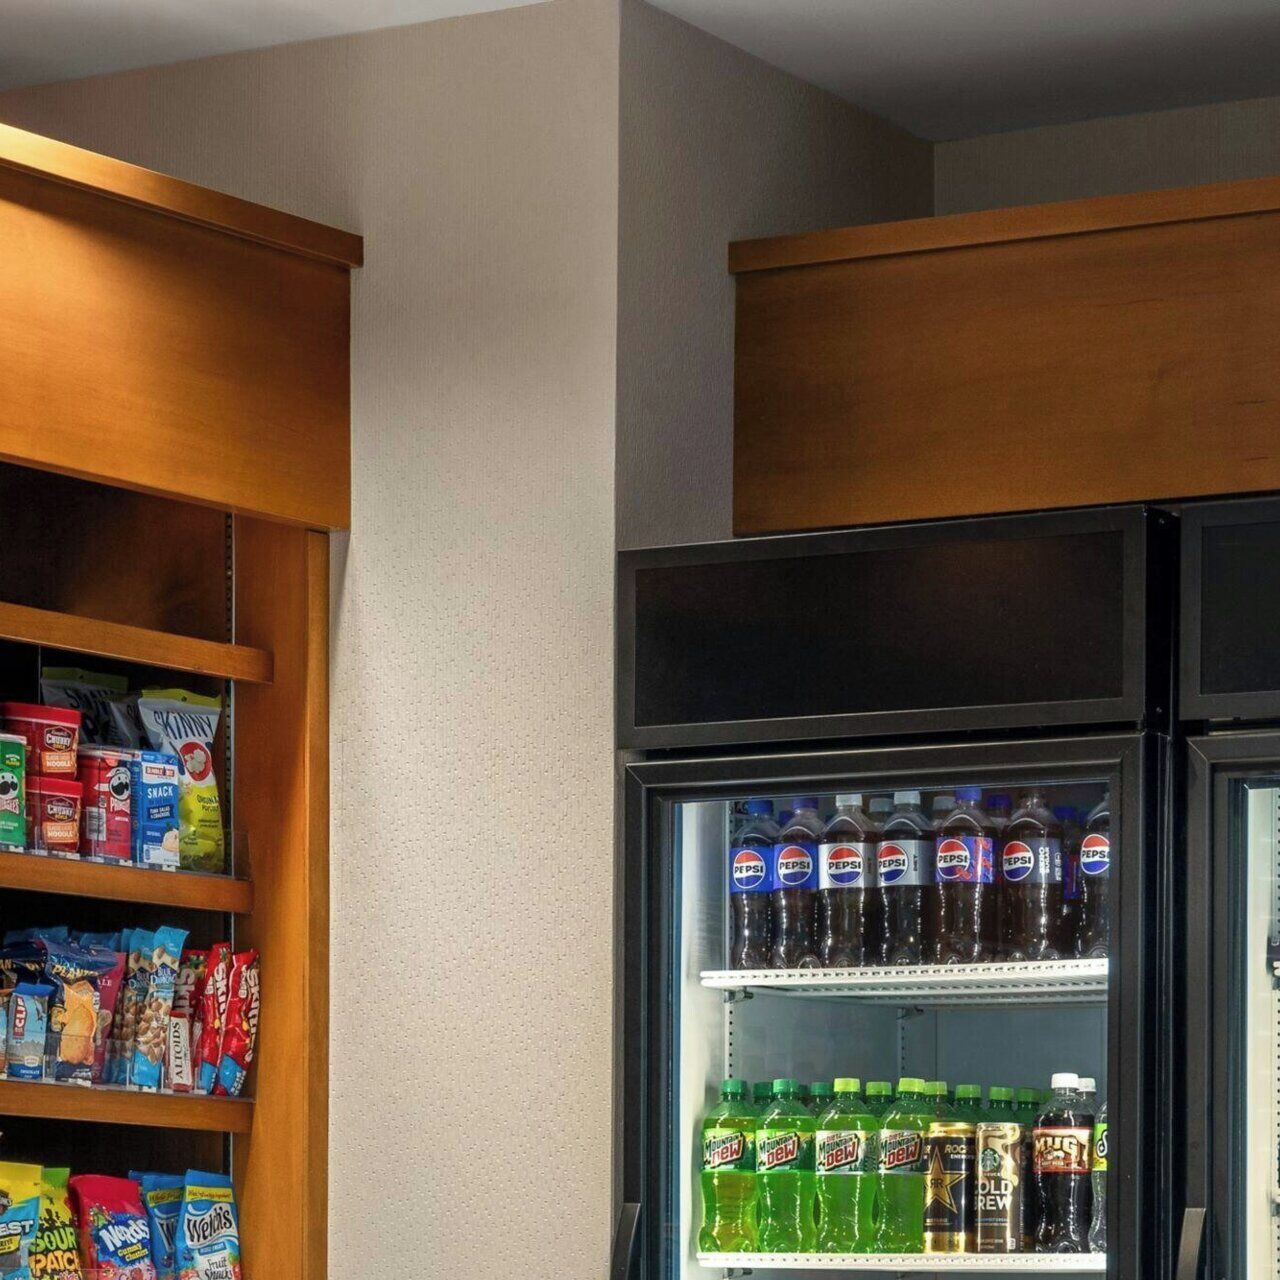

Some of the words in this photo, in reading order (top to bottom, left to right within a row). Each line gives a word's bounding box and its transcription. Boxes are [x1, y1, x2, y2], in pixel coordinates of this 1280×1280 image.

[147, 786, 173, 798] SNACK
[879, 858, 905, 868] PEPSI
[939, 854, 968, 864] PEPSI
[1004, 856, 1032, 866] PEPSI
[735, 865, 763, 874] PEPSI
[780, 860, 810, 870] PEPSI
[829, 860, 861, 870] PEPSI
[173, 1022, 183, 1083] ALTOIDS
[1036, 1136, 1078, 1154] MUG
[187, 1206, 232, 1242] Welch's
[30, 1227, 77, 1252] SOUR
